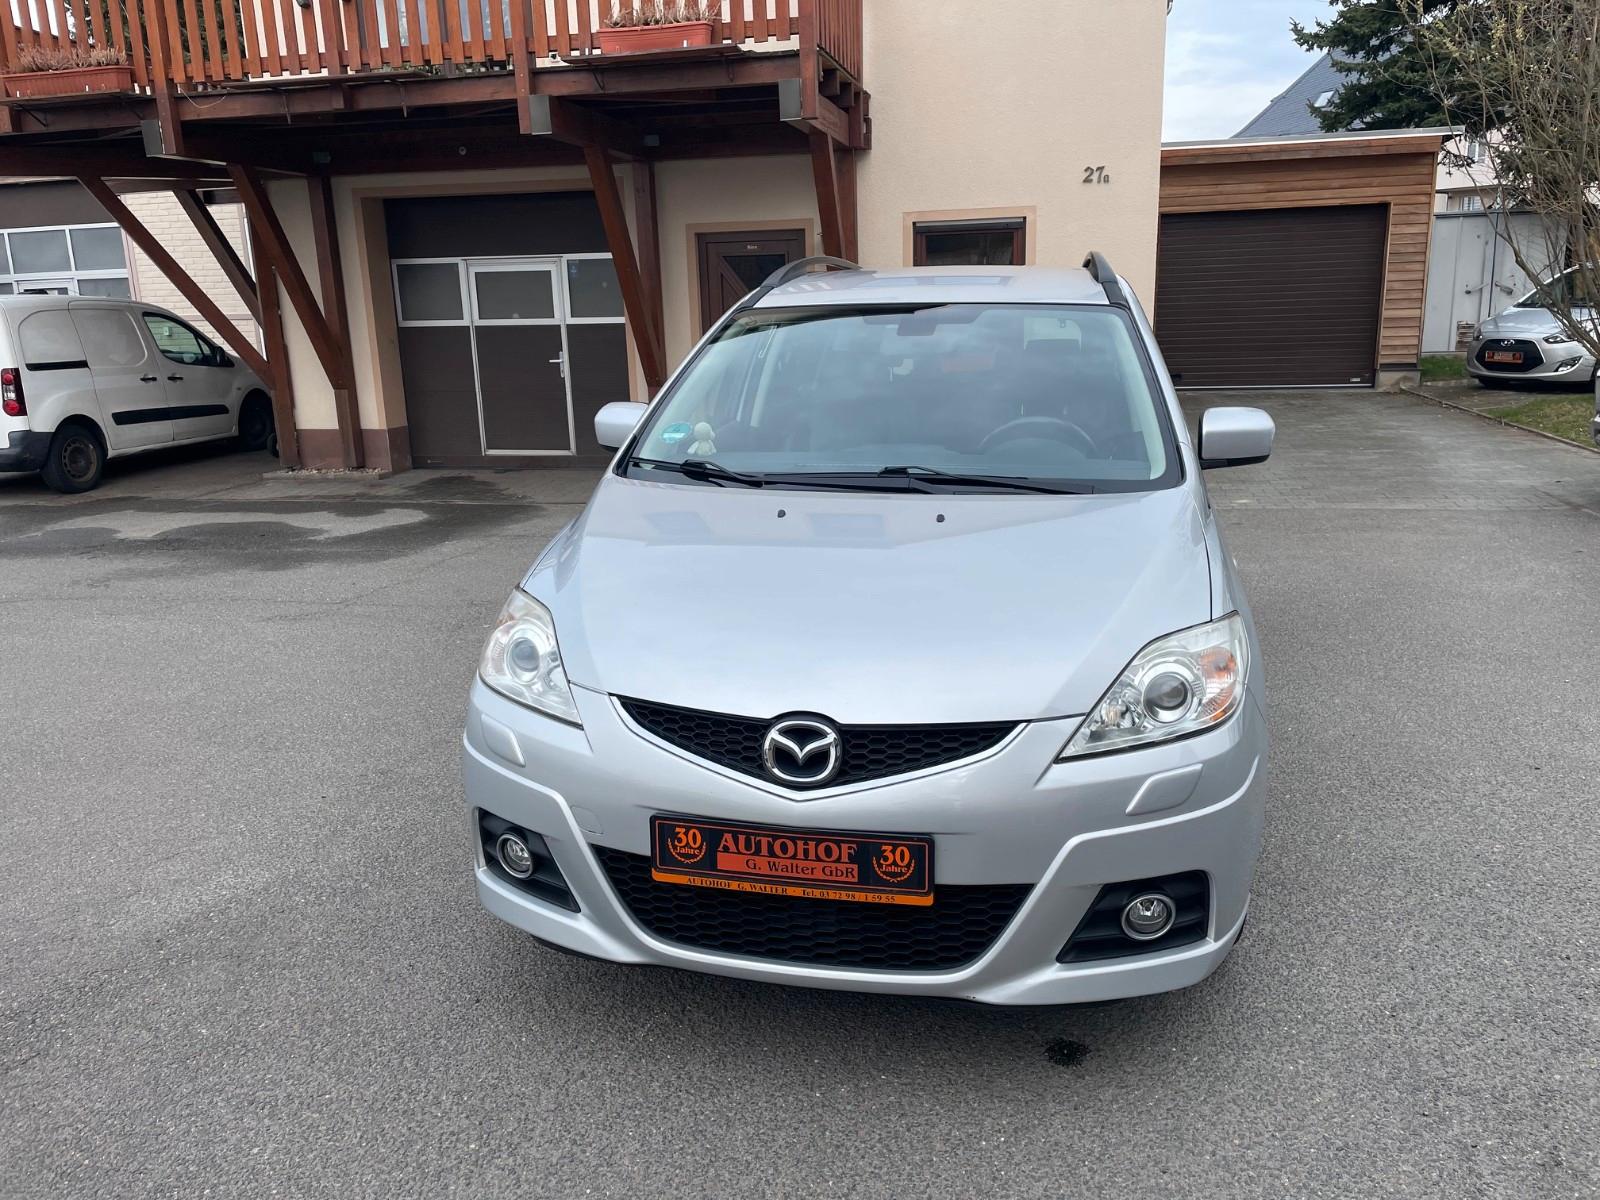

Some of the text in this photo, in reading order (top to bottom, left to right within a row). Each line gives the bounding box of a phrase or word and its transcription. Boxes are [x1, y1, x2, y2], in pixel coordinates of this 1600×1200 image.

[674, 827, 702, 849] 30
[718, 832, 858, 863] AUTOHOF
[675, 846, 700, 856] Jahre
[880, 845, 911, 867] 30
[745, 858, 856, 879] G. Walter GbR
[880, 864, 909, 873] Jahre
[687, 877, 732, 889] AUTOHOF
[737, 883, 747, 892] G.
[749, 883, 788, 895] WALTER
[801, 889, 817, 898] Tel.
[845, 891, 857, 901] 98
[885, 895, 897, 904] 55
